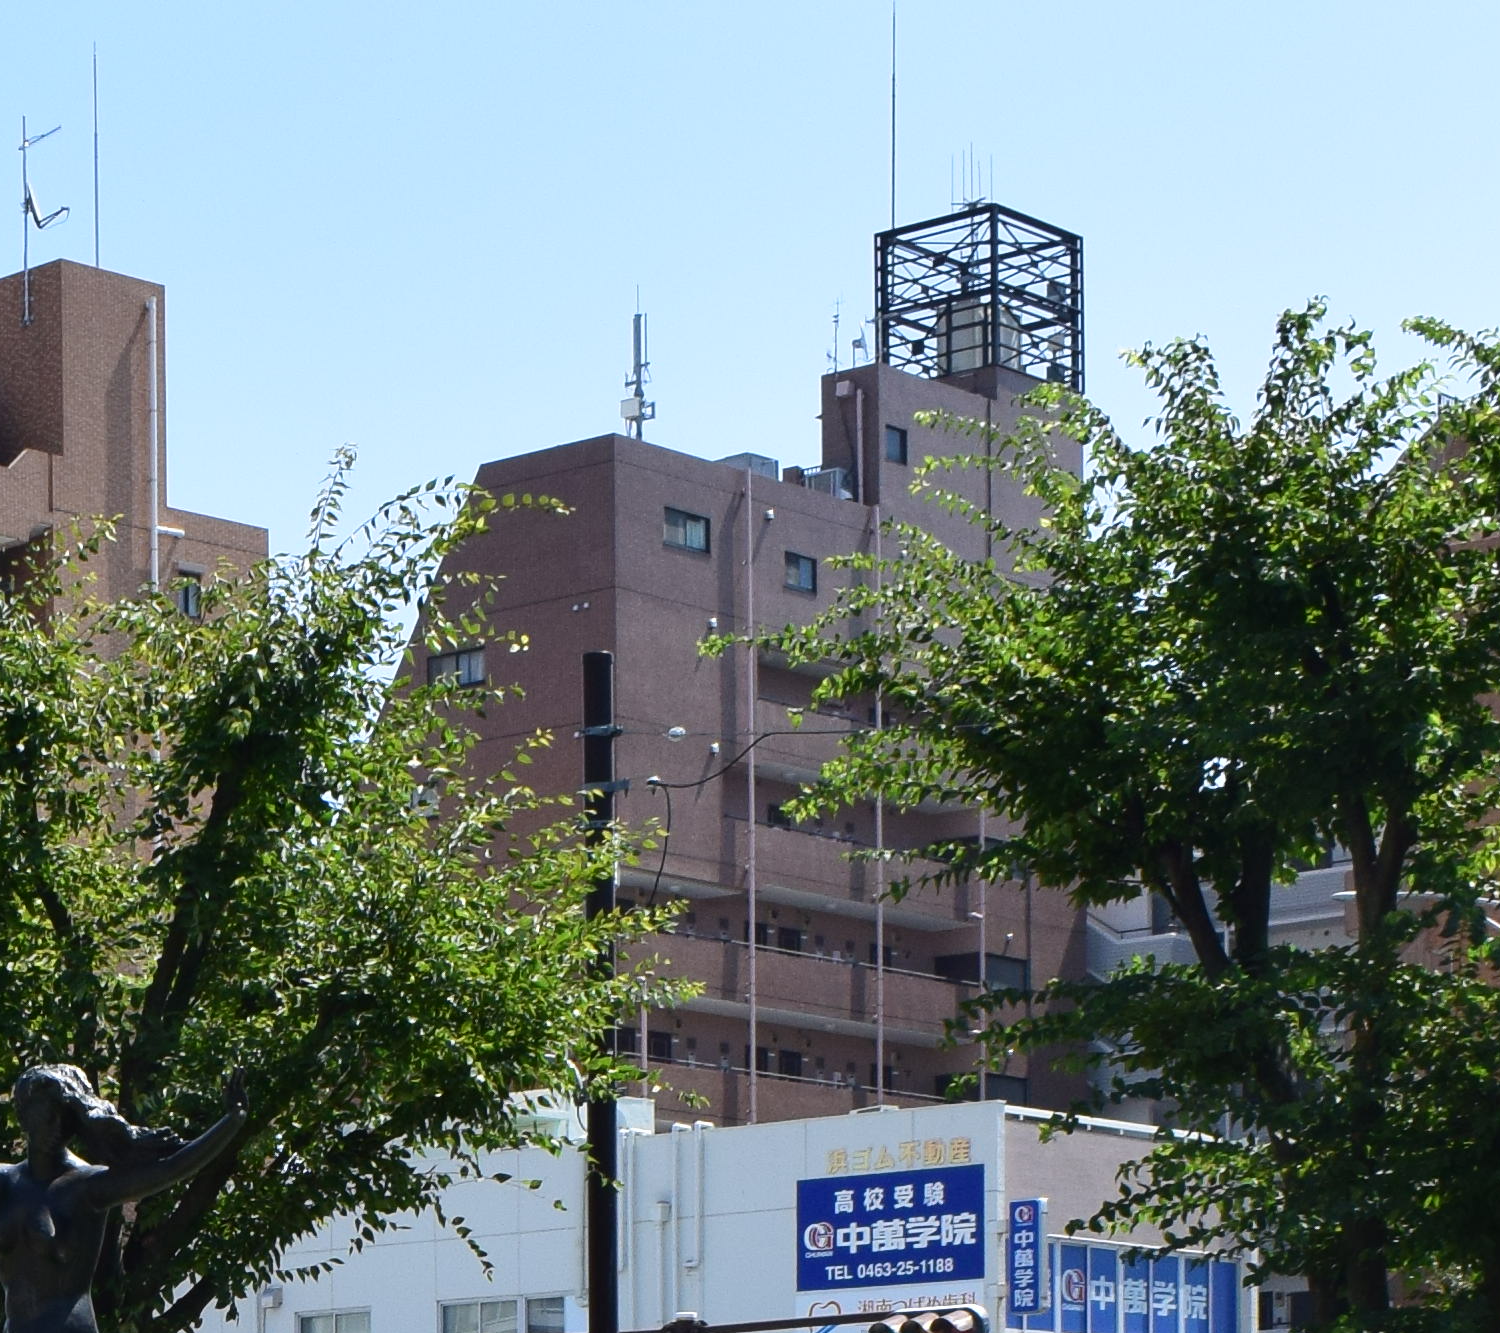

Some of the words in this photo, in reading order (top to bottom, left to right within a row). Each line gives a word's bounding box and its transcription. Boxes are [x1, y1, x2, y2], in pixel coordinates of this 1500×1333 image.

[827, 1138, 973, 1173] 浜ゴム不動産
[834, 1181, 945, 1214] 高校受験
[836, 1211, 977, 1254] 中萬学院
[826, 1264, 853, 1280] TEL
[857, 1257, 954, 1278] 0463-25-1188
[1013, 1229, 1034, 1307] 中萬学院
[1090, 1274, 1208, 1320] 中萬学院
